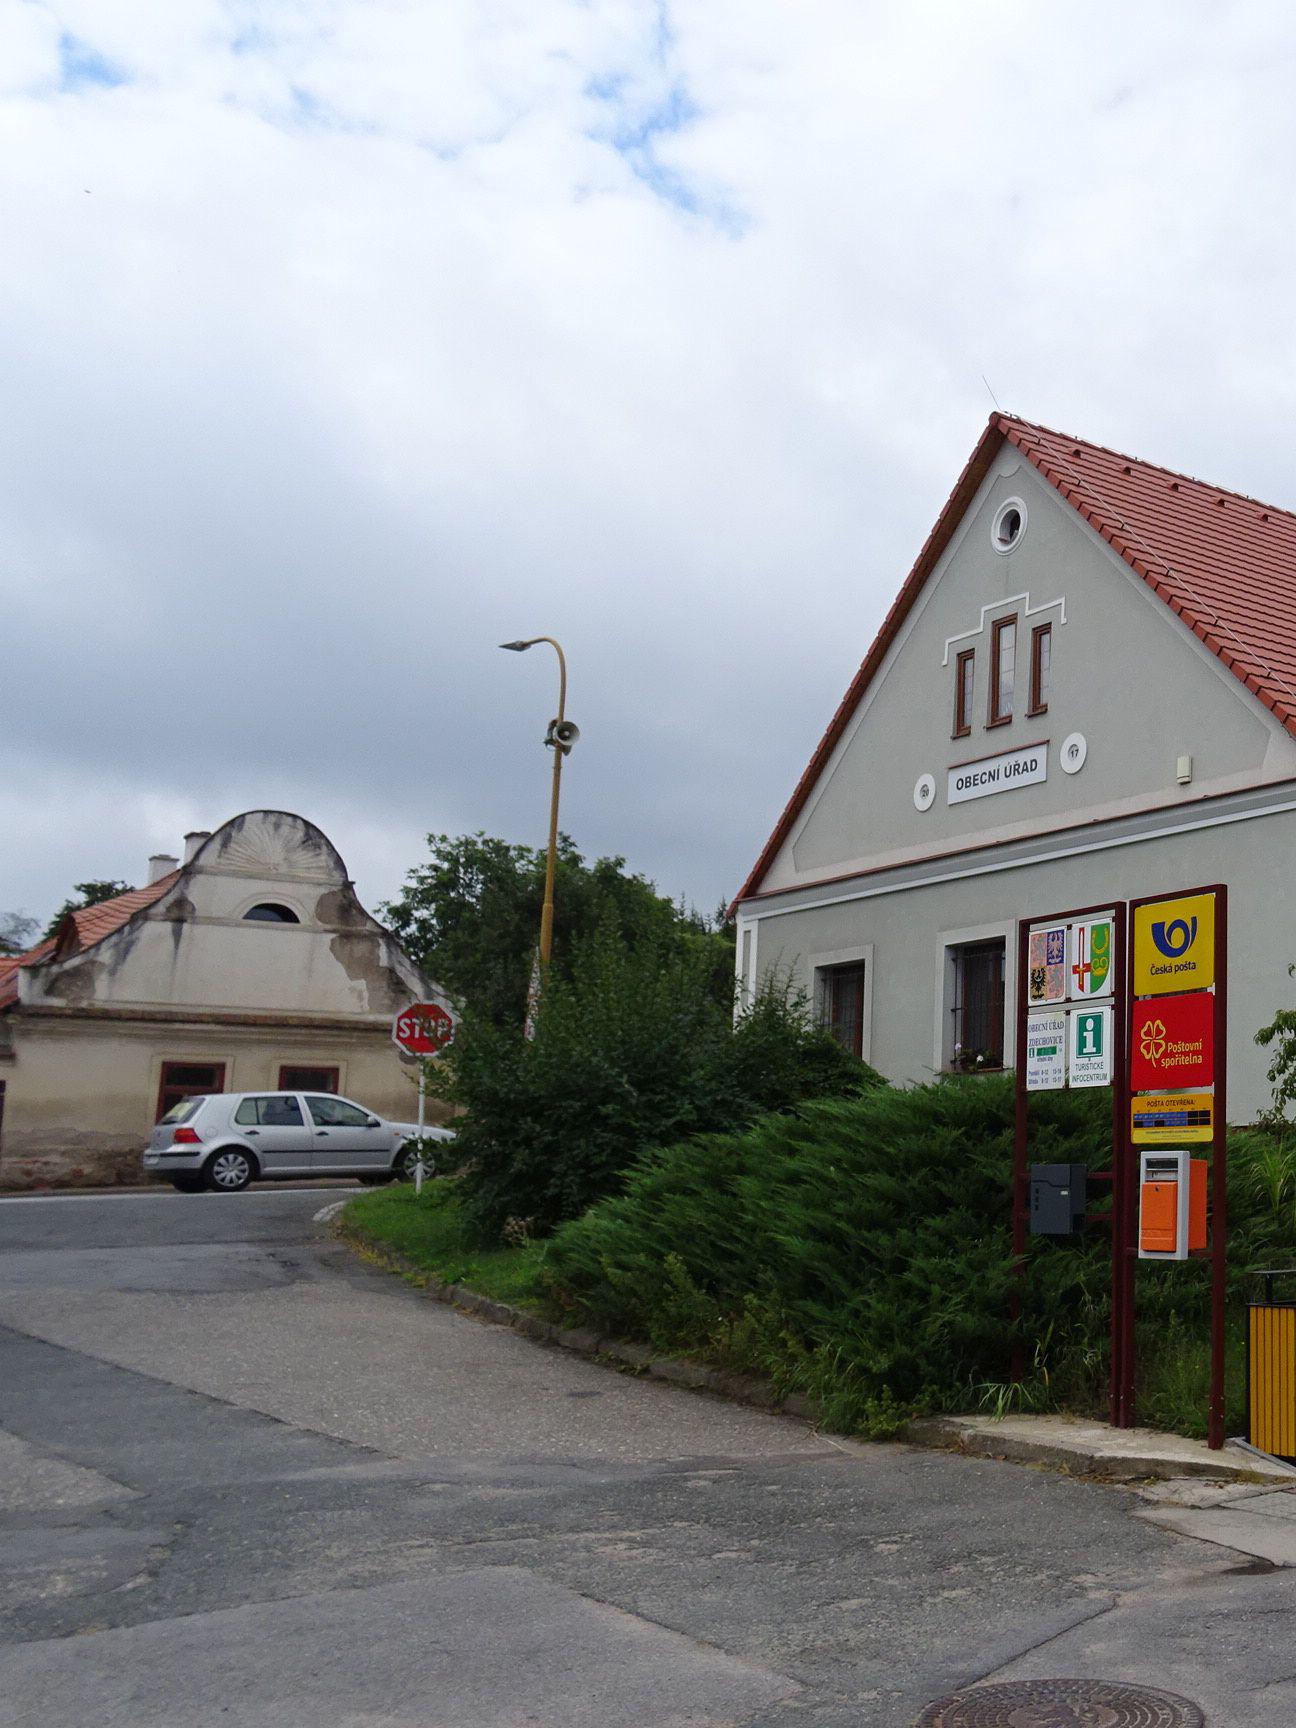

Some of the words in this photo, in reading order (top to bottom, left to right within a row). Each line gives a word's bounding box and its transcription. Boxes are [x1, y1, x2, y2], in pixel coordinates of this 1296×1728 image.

[955, 766, 1000, 791] OBECNÍ
[1004, 758, 1038, 778] ÚŘAD
[1150, 963, 1173, 976] Česká
[1174, 961, 1197, 974] pošta
[1168, 1038, 1203, 1053] Poštovní
[1161, 1053, 1203, 1069] spořitelna
[1072, 1073, 1108, 1083] INFOCENTRUM
[1146, 1099, 1164, 1108] POŠTA
